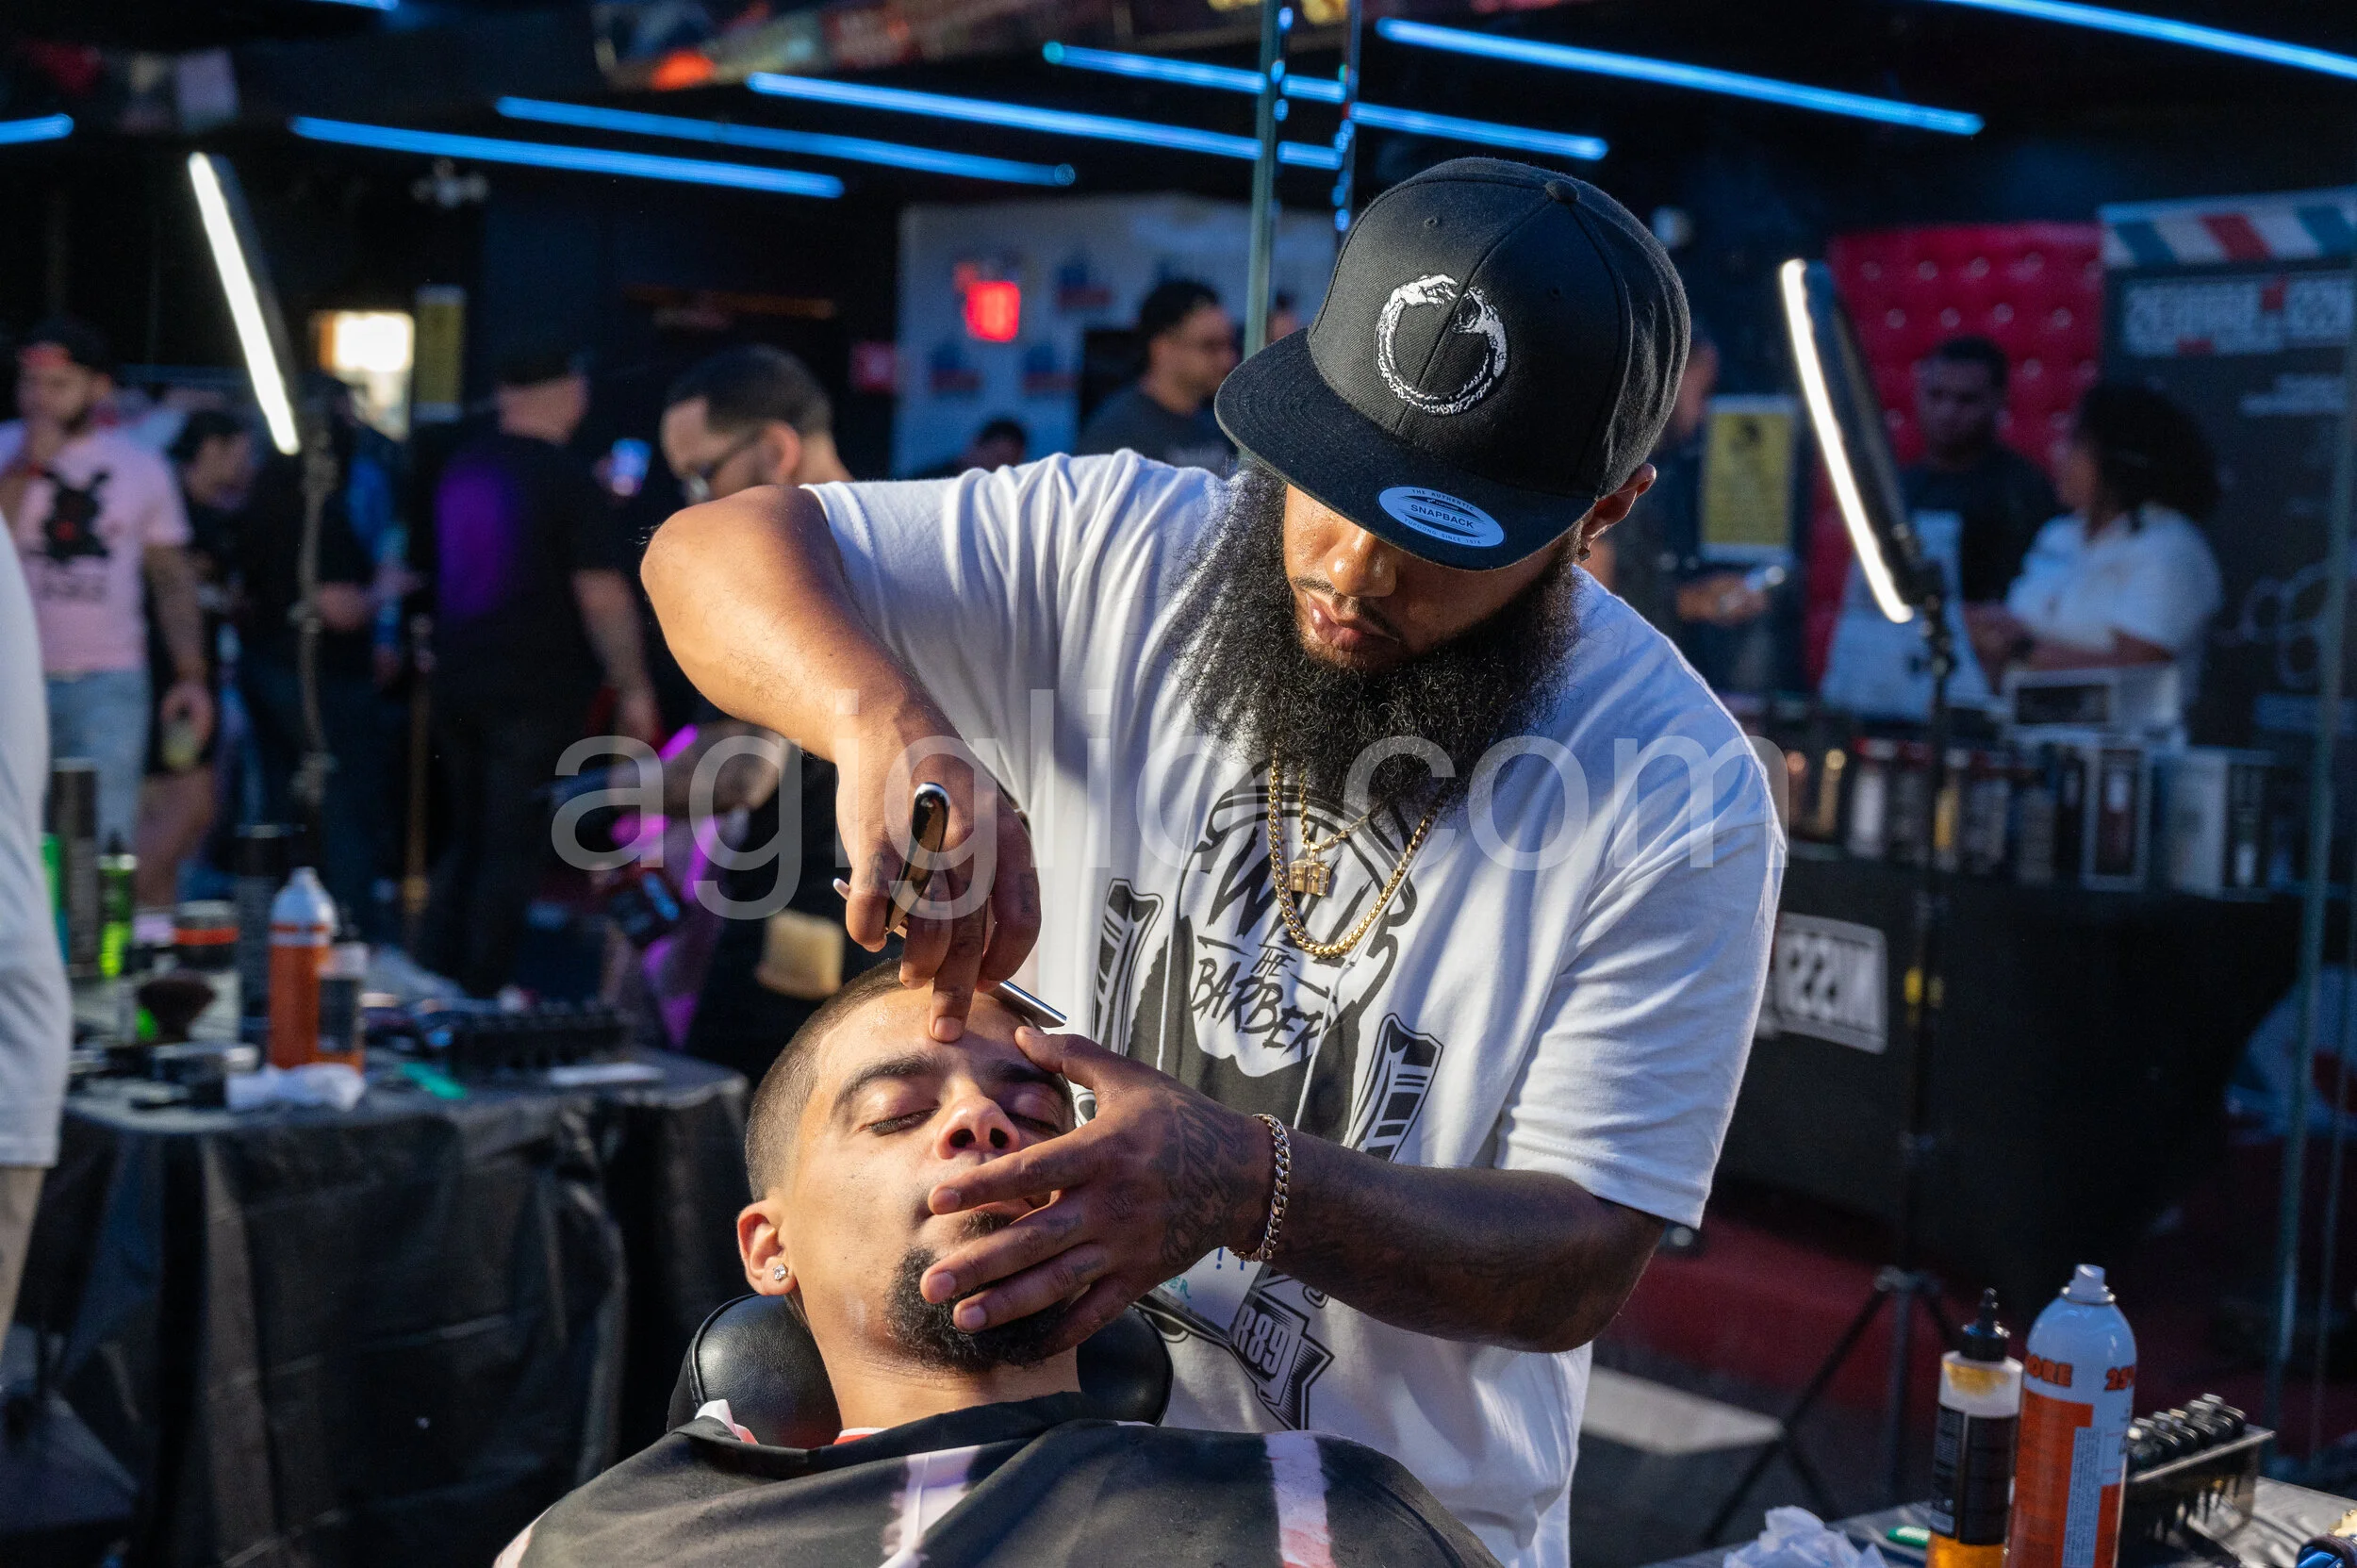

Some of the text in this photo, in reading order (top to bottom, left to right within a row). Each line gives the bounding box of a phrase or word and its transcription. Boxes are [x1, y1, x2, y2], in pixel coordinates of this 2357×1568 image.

[1431, 491, 1475, 511] AUTHENTIC
[1410, 503, 1475, 529] SNAPBACK
[1442, 533, 1461, 544] SINCE
[1250, 943, 1297, 977] THE
[1190, 956, 1332, 1065] BARBER
